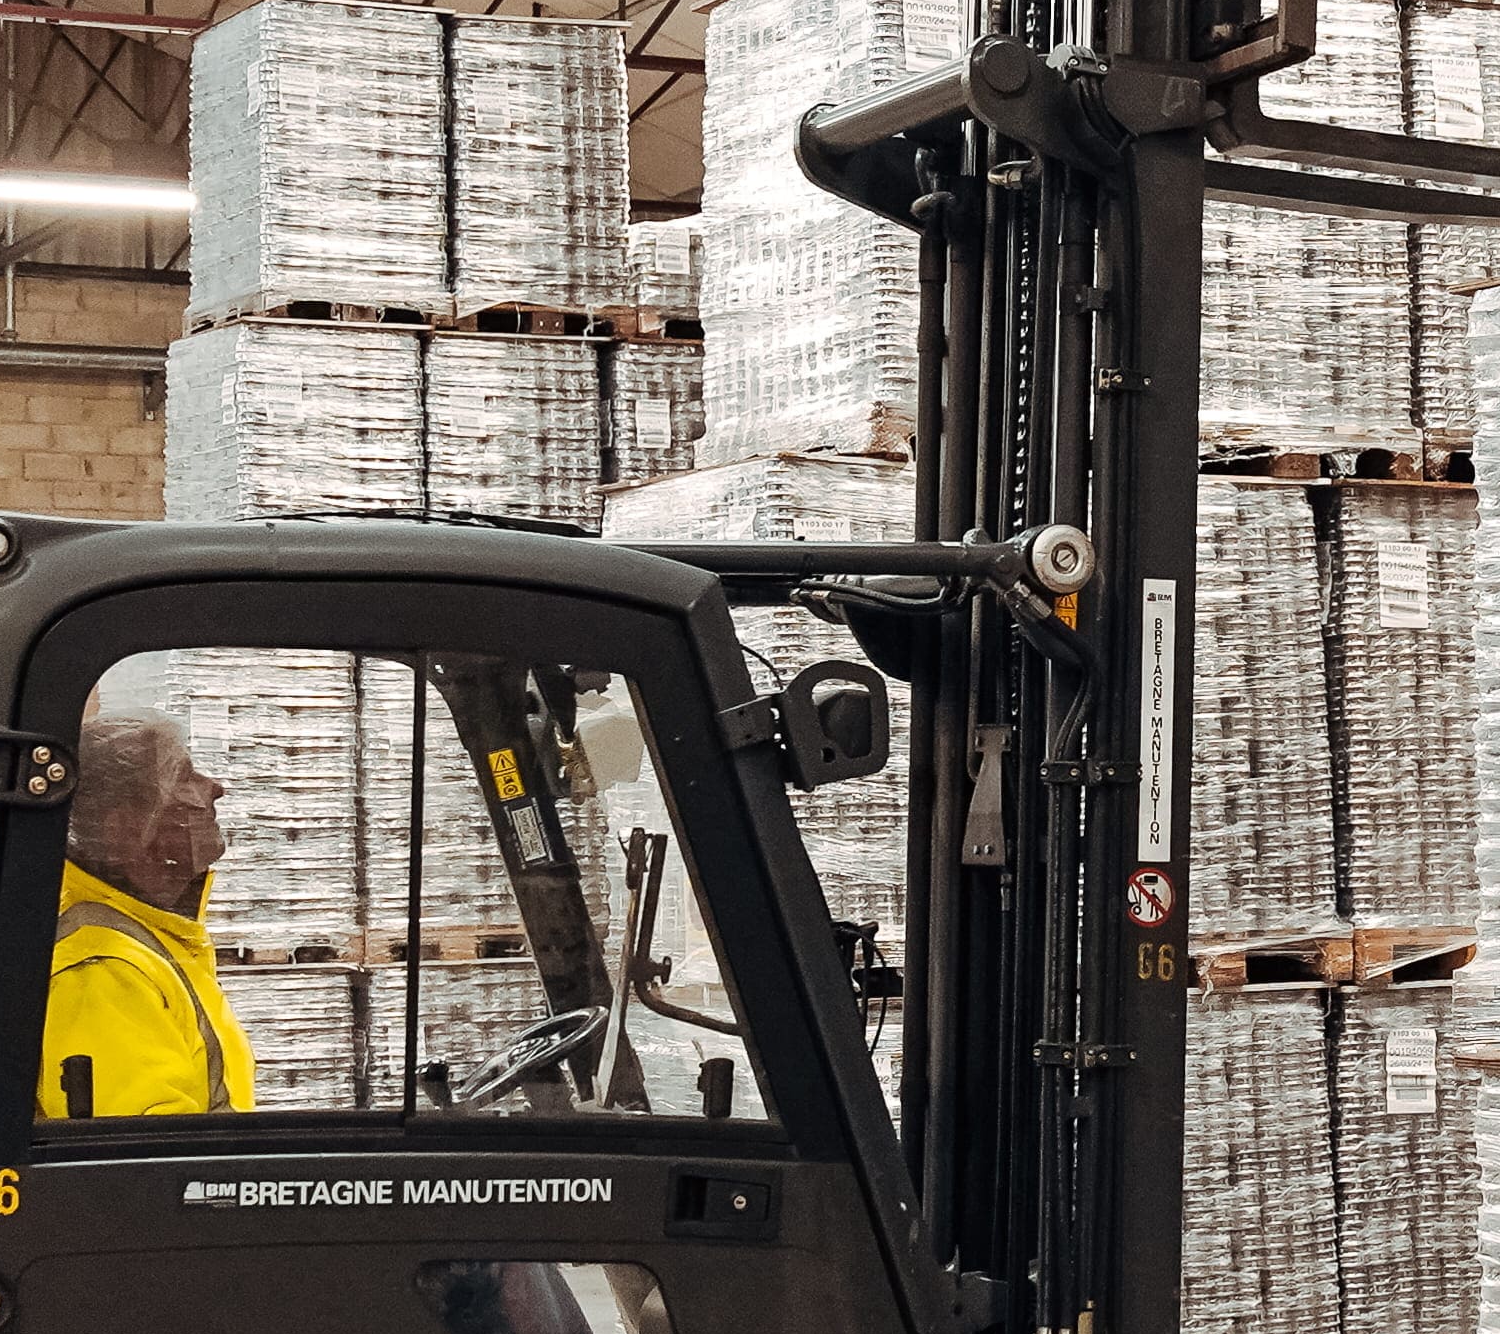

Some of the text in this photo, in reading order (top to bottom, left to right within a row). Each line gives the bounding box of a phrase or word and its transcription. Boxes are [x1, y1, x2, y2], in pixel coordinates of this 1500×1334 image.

[1150, 617, 1164, 845] BRETAGNE MANUTENTION
[1138, 941, 1175, 982] G6
[205, 1182, 237, 1197] BM
[239, 1179, 394, 1206] BRETAGNE
[402, 1177, 612, 1205] MANUTENTION
